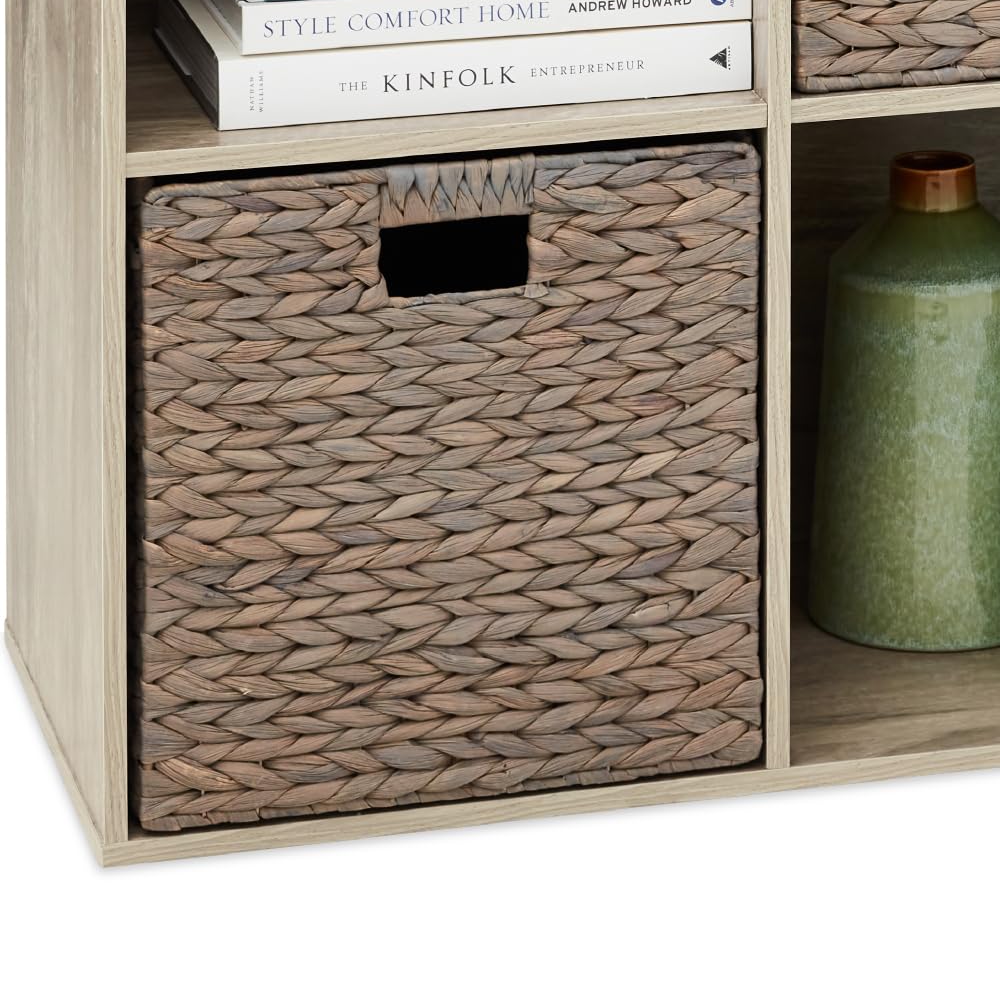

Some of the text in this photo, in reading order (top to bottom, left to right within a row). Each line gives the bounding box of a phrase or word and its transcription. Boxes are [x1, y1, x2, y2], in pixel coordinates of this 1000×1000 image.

[263, 1, 550, 38] STYLE COMFORT HOME
[568, 0, 628, 13] ANDREW
[339, 59, 646, 93] THE KINFOLK ENTREPRENEUR
